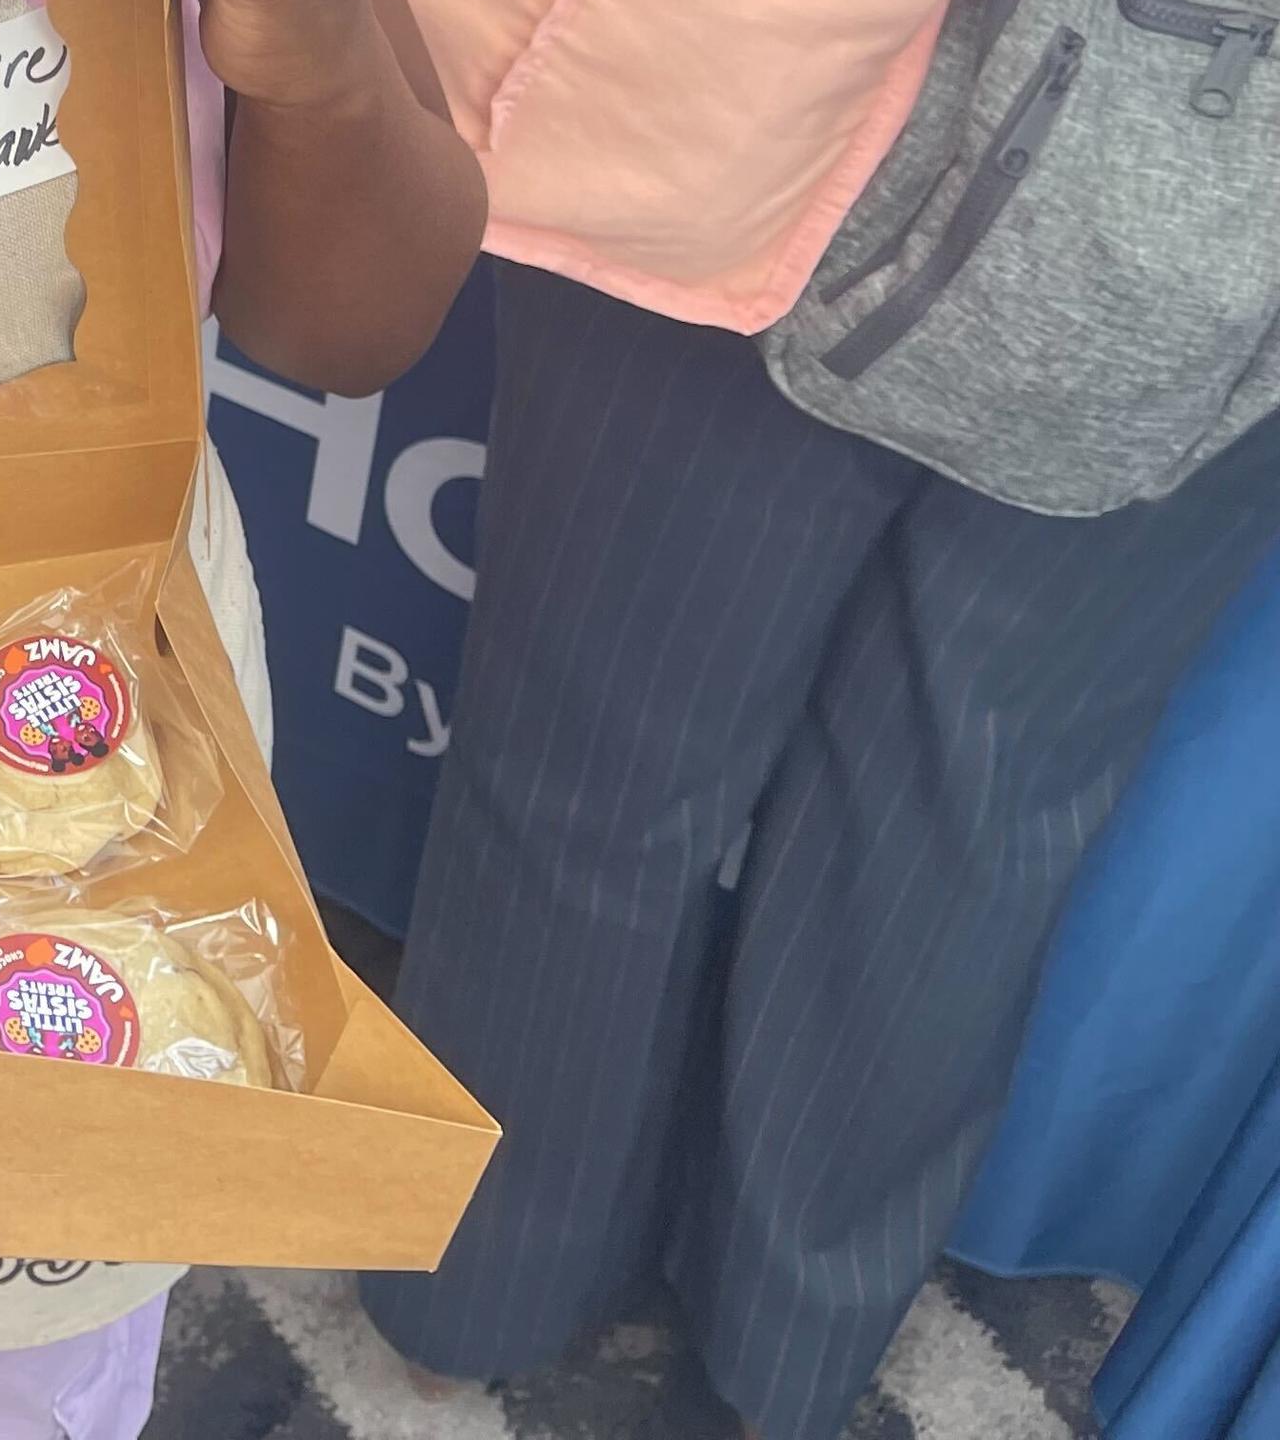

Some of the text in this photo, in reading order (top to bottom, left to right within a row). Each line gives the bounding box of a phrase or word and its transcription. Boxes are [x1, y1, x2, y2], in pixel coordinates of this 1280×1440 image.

[24, 638, 96, 667] JAMZ
[8, 675, 81, 721] SISTAS
[12, 670, 60, 699] TREATS
[25, 693, 81, 726] LITTLE
[53, 943, 124, 1004] JAMZ
[19, 979, 74, 998] TREATS
[7, 990, 93, 1019] SISTAS
[20, 1011, 84, 1033] LITTLE
